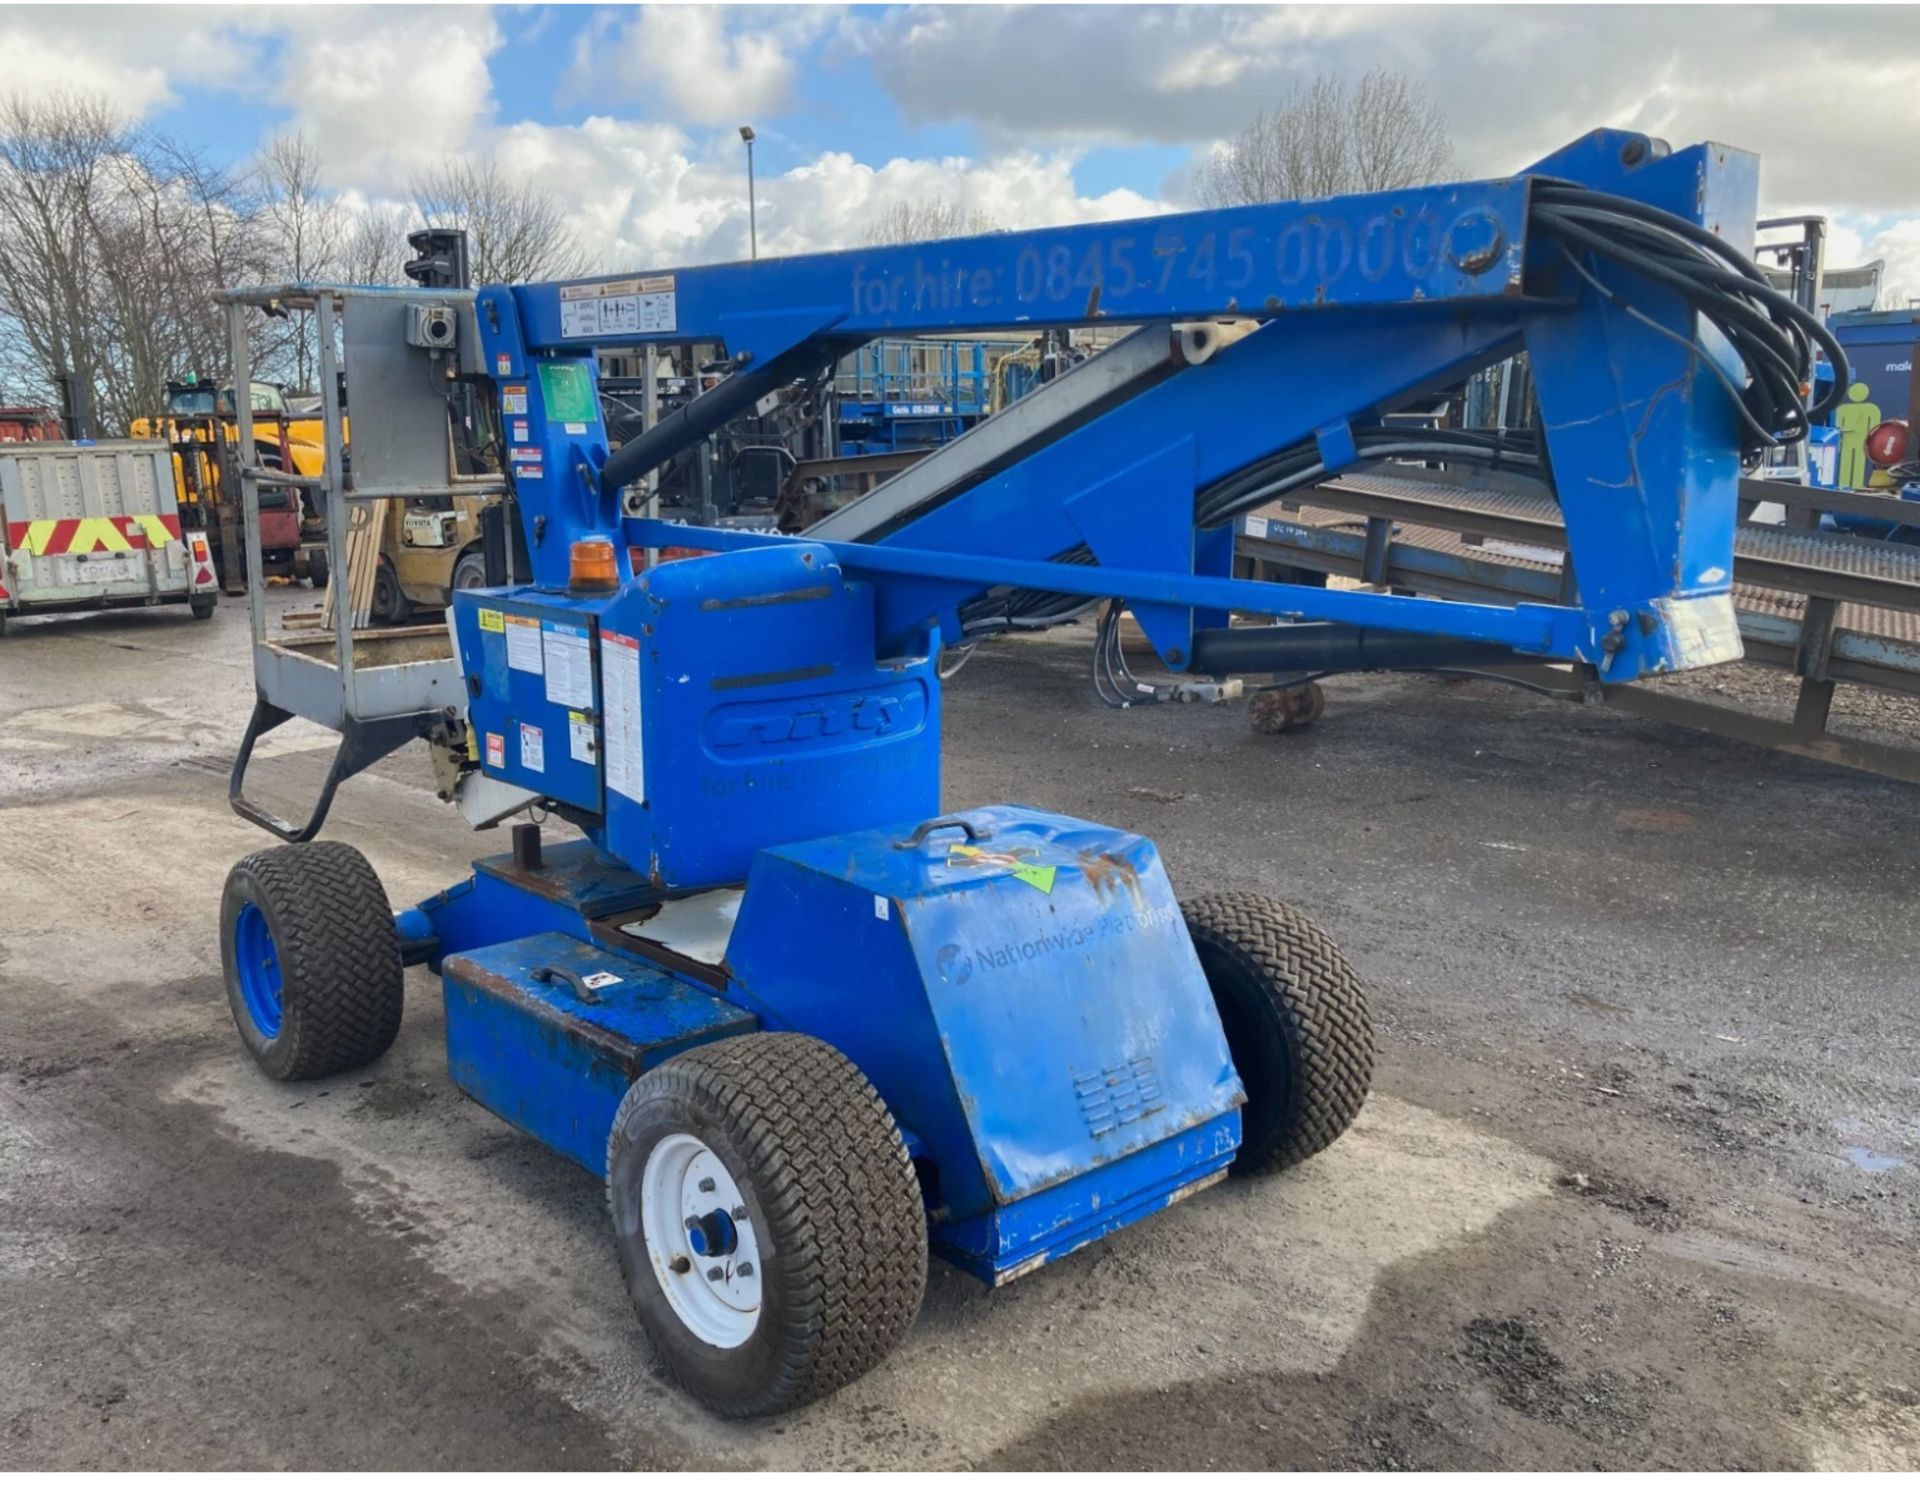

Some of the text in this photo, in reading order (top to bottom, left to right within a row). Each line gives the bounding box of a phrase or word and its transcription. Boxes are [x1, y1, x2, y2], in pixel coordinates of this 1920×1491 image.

[850, 260, 905, 315] for
[1015, 239, 1136, 303] 0845
[1154, 228, 1256, 294] 745
[1276, 209, 1442, 285] 0000
